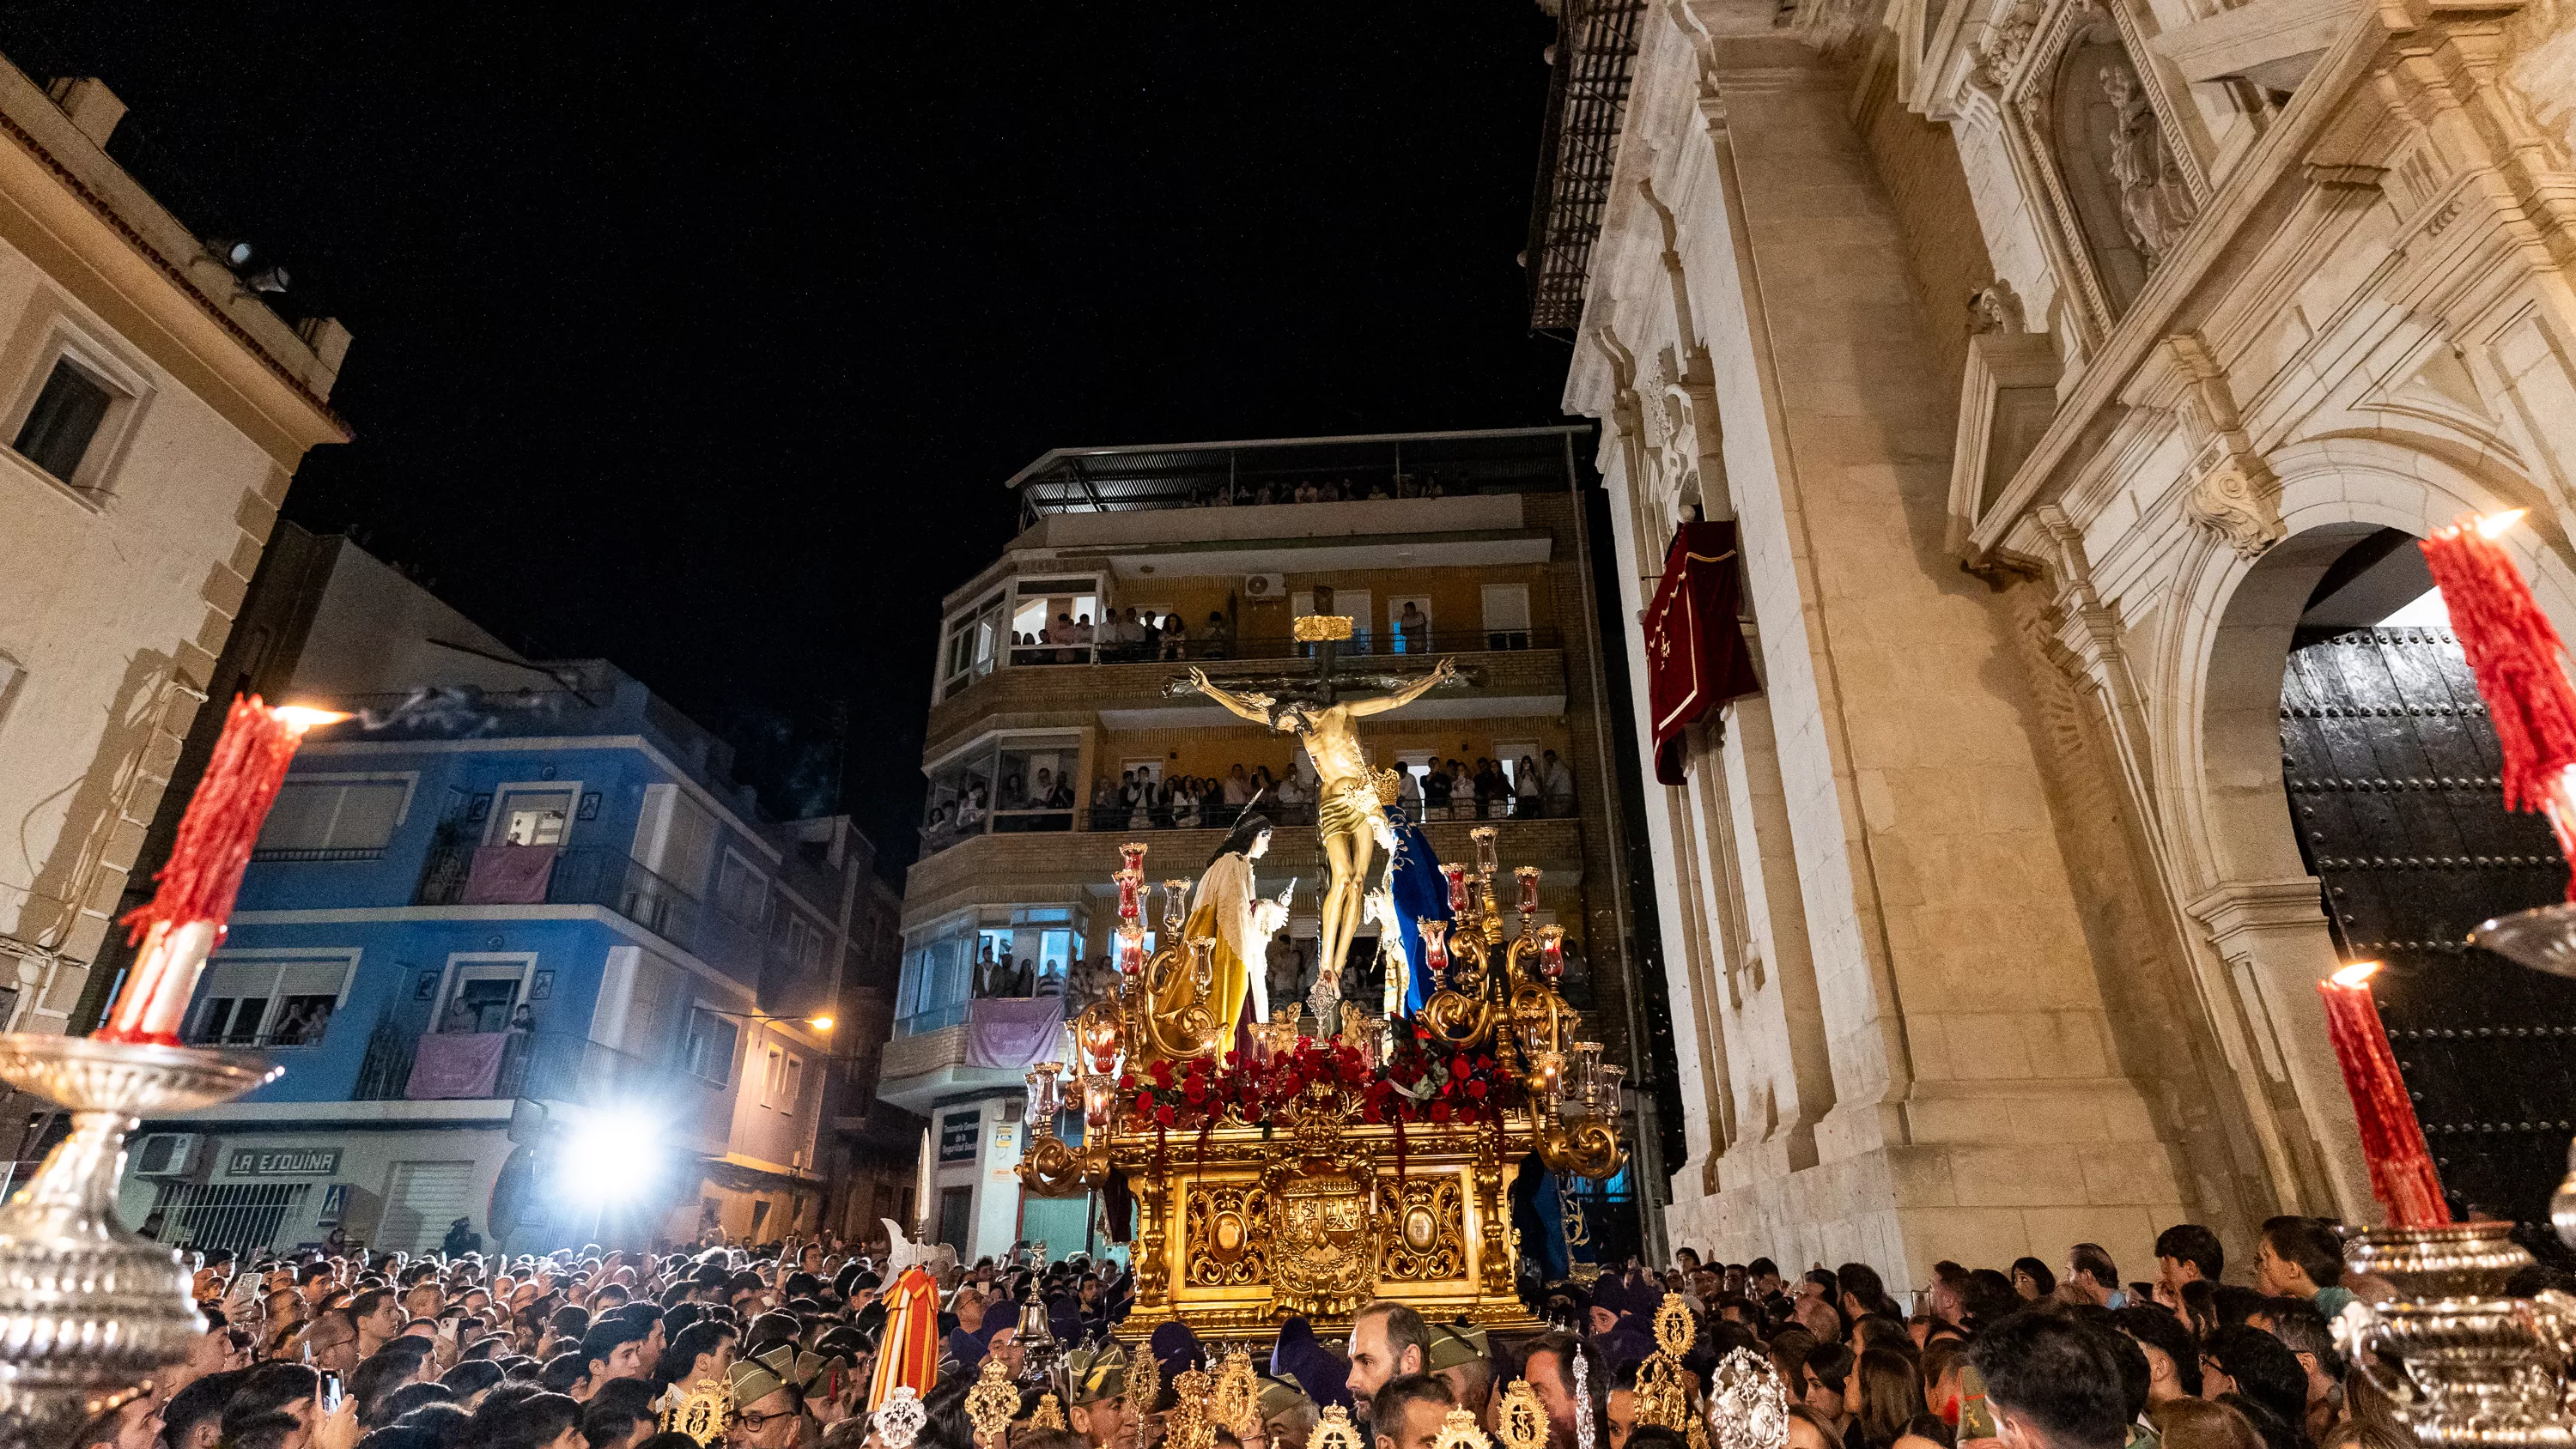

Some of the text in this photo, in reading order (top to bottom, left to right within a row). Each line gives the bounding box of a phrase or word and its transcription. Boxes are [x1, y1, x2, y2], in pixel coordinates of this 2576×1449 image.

[231, 1150, 335, 1171] LA ESQUINA
[1653, 1199, 1662, 1210] 3
